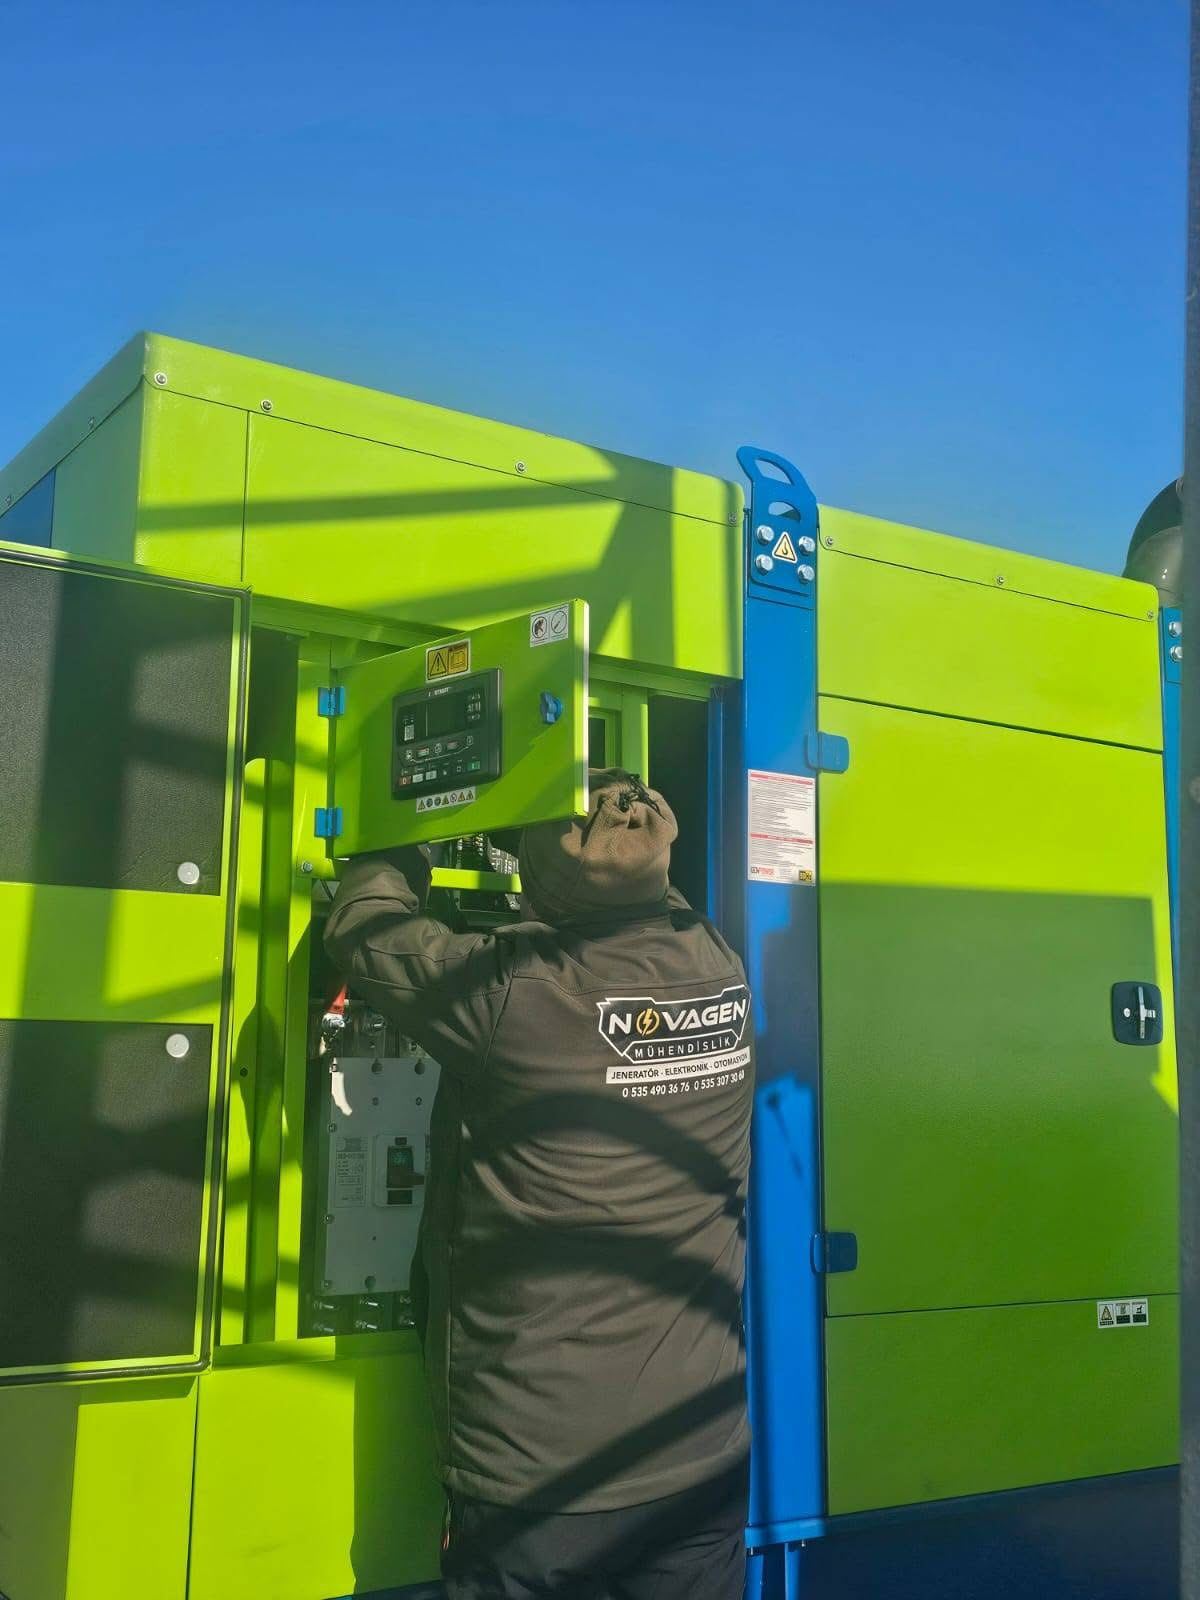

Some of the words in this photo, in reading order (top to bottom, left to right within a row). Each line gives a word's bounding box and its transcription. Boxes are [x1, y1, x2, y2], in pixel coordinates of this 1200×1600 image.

[622, 1087, 629, 1098] 0
[631, 1085, 648, 1097] 535
[650, 1084, 666, 1095] 490
[668, 1083, 678, 1094] 36
[680, 1081, 690, 1093] 76
[694, 1080, 700, 1091] 0
[701, 1078, 715, 1090] 535
[716, 1074, 729, 1087] 307
